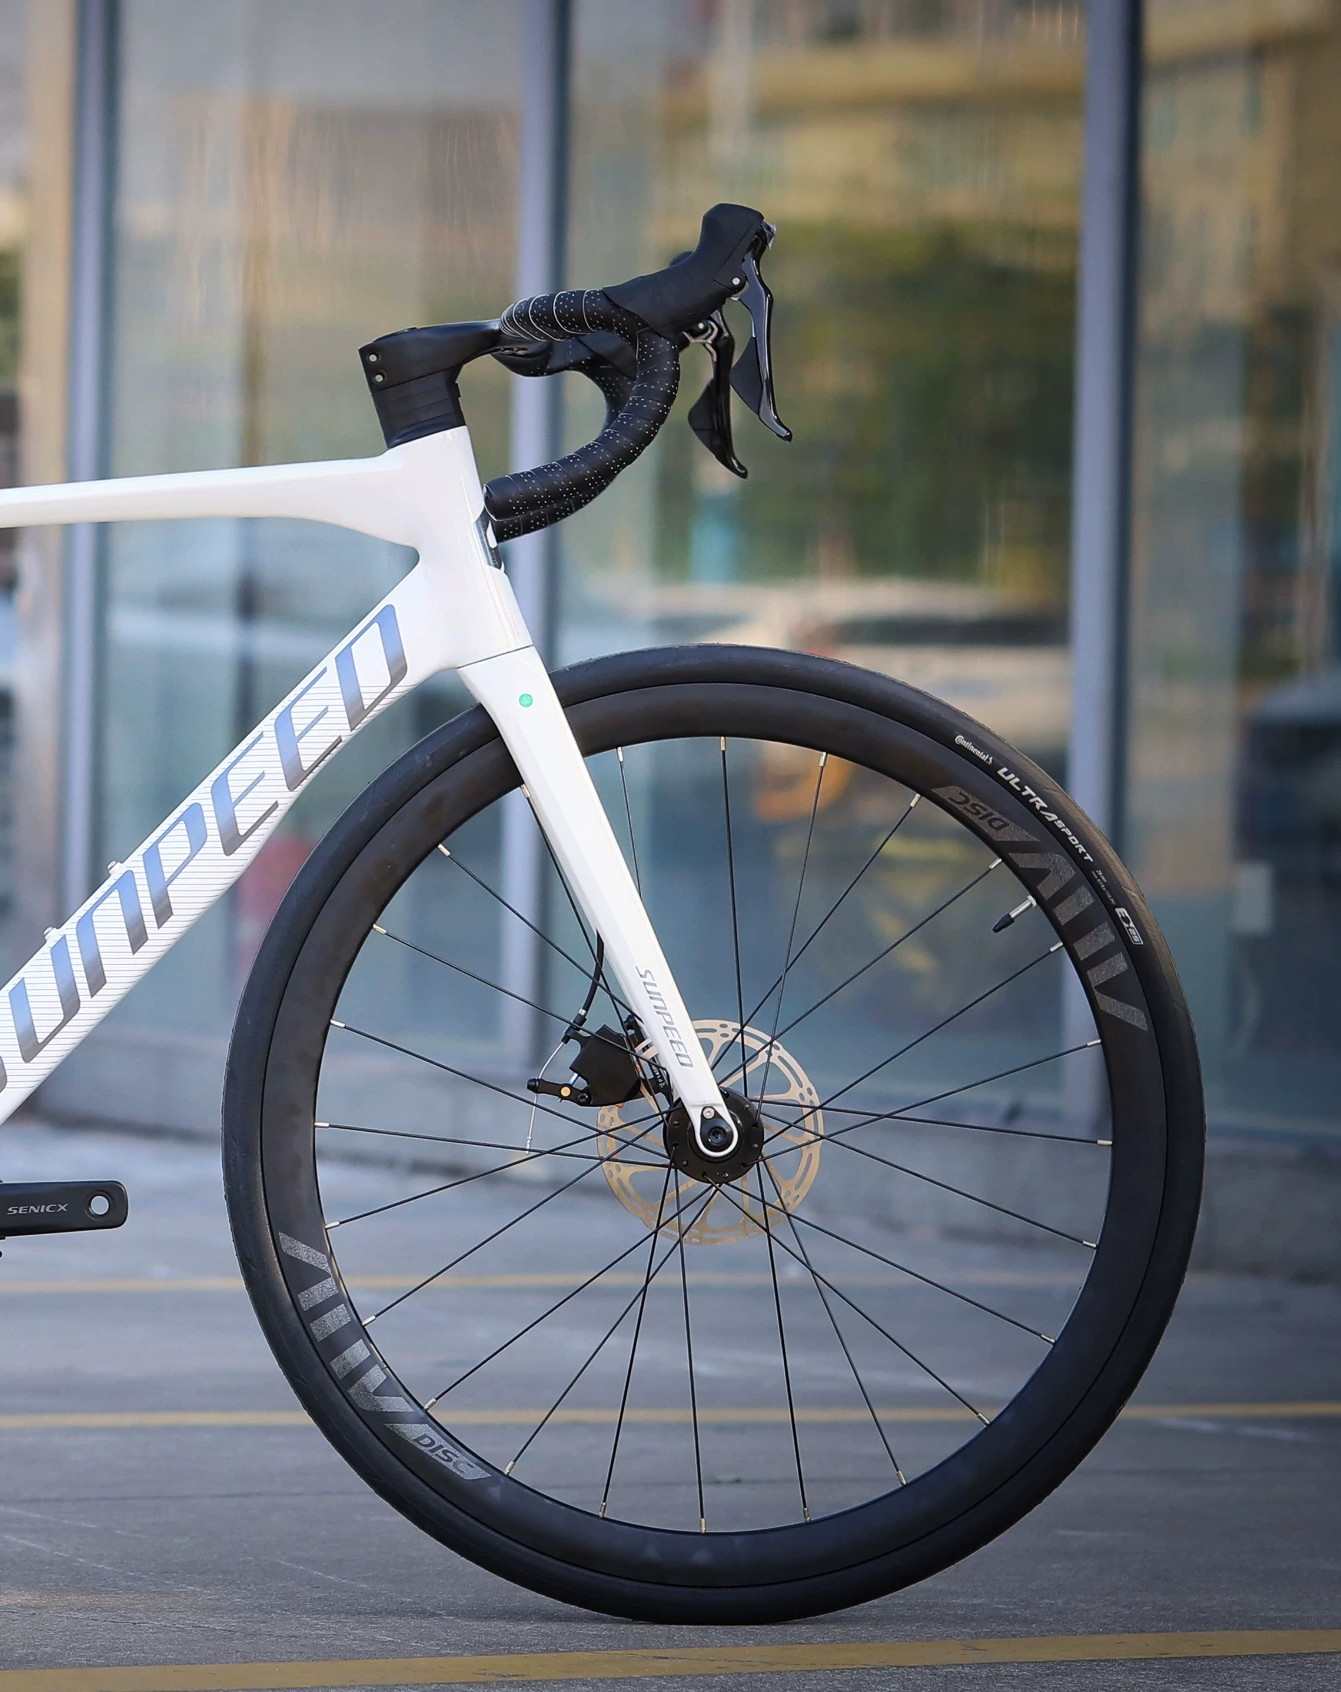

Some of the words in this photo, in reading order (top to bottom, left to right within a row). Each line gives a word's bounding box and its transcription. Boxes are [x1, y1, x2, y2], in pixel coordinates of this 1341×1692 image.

[950, 790, 1010, 832] DISC
[635, 965, 694, 1068] SUNPEED
[7, 1203, 69, 1215] SENICX
[413, 1431, 475, 1475] DISC
